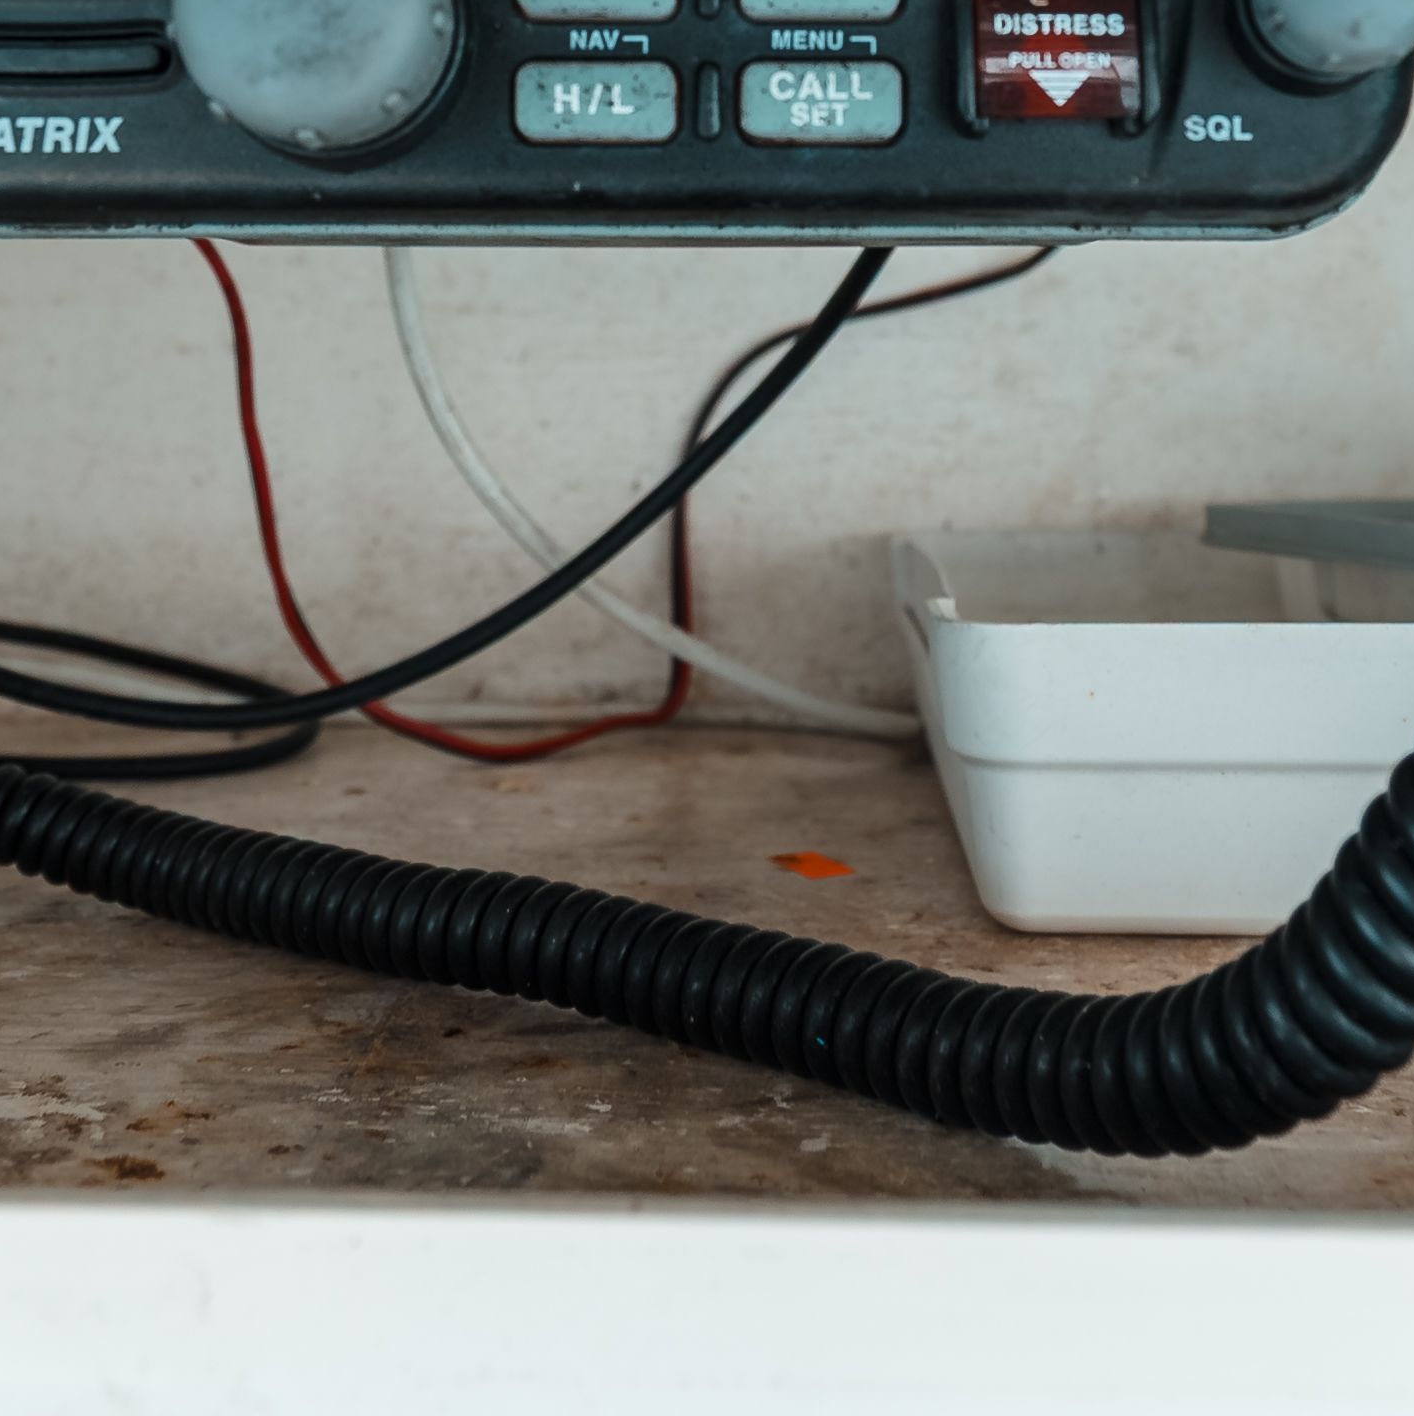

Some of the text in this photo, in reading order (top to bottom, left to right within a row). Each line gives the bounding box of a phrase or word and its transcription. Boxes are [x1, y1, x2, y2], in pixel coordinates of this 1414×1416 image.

[993, 13, 1126, 37] DISTRESS
[569, 30, 620, 51] NAV
[771, 30, 845, 51] MENU
[1007, 51, 1112, 70] PULL OPEN
[769, 70, 874, 101] CALL
[553, 84, 635, 116] H/L
[790, 102, 850, 128] SET
[1184, 115, 1254, 142] SQL
